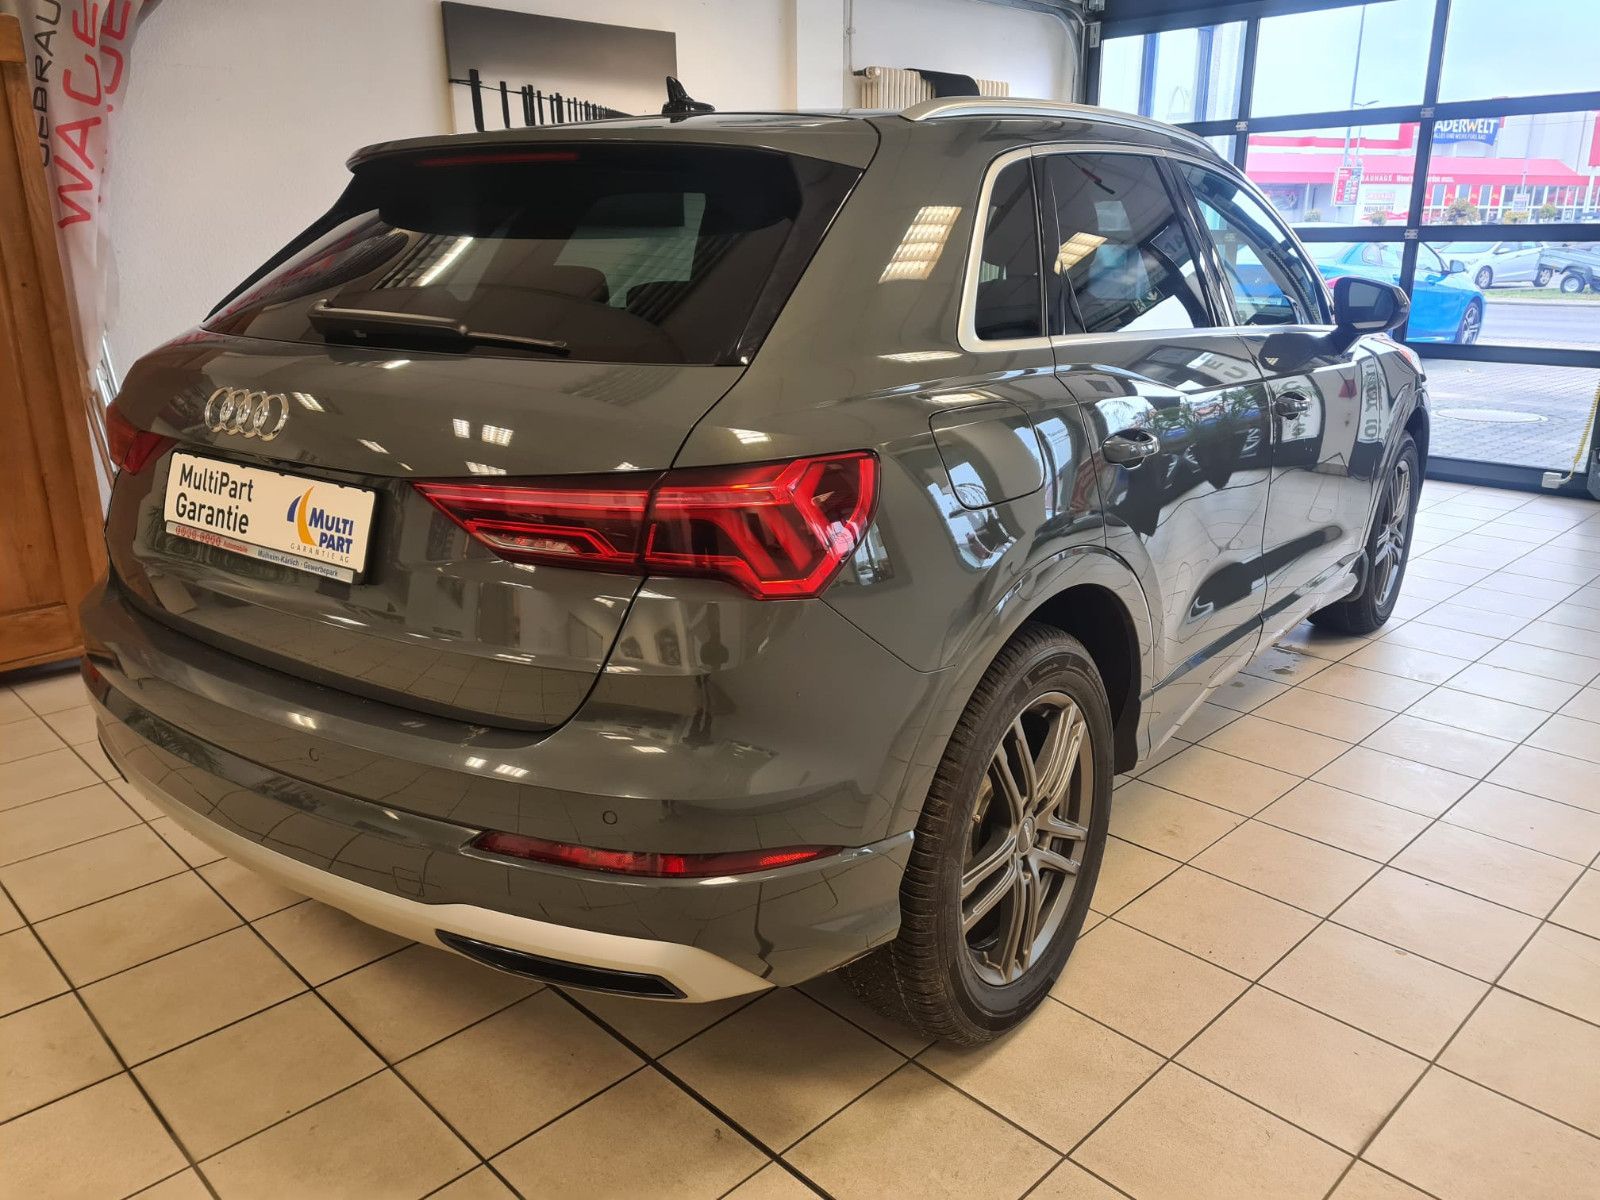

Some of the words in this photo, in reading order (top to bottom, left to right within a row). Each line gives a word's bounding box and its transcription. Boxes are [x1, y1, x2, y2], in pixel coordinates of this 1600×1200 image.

[179, 463, 254, 502] MultiPart
[175, 492, 249, 534] Garantie
[309, 507, 354, 536] MULTI
[290, 542, 336, 560] GARANTIE
[339, 555, 350, 564] AG
[318, 532, 353, 555] PART
